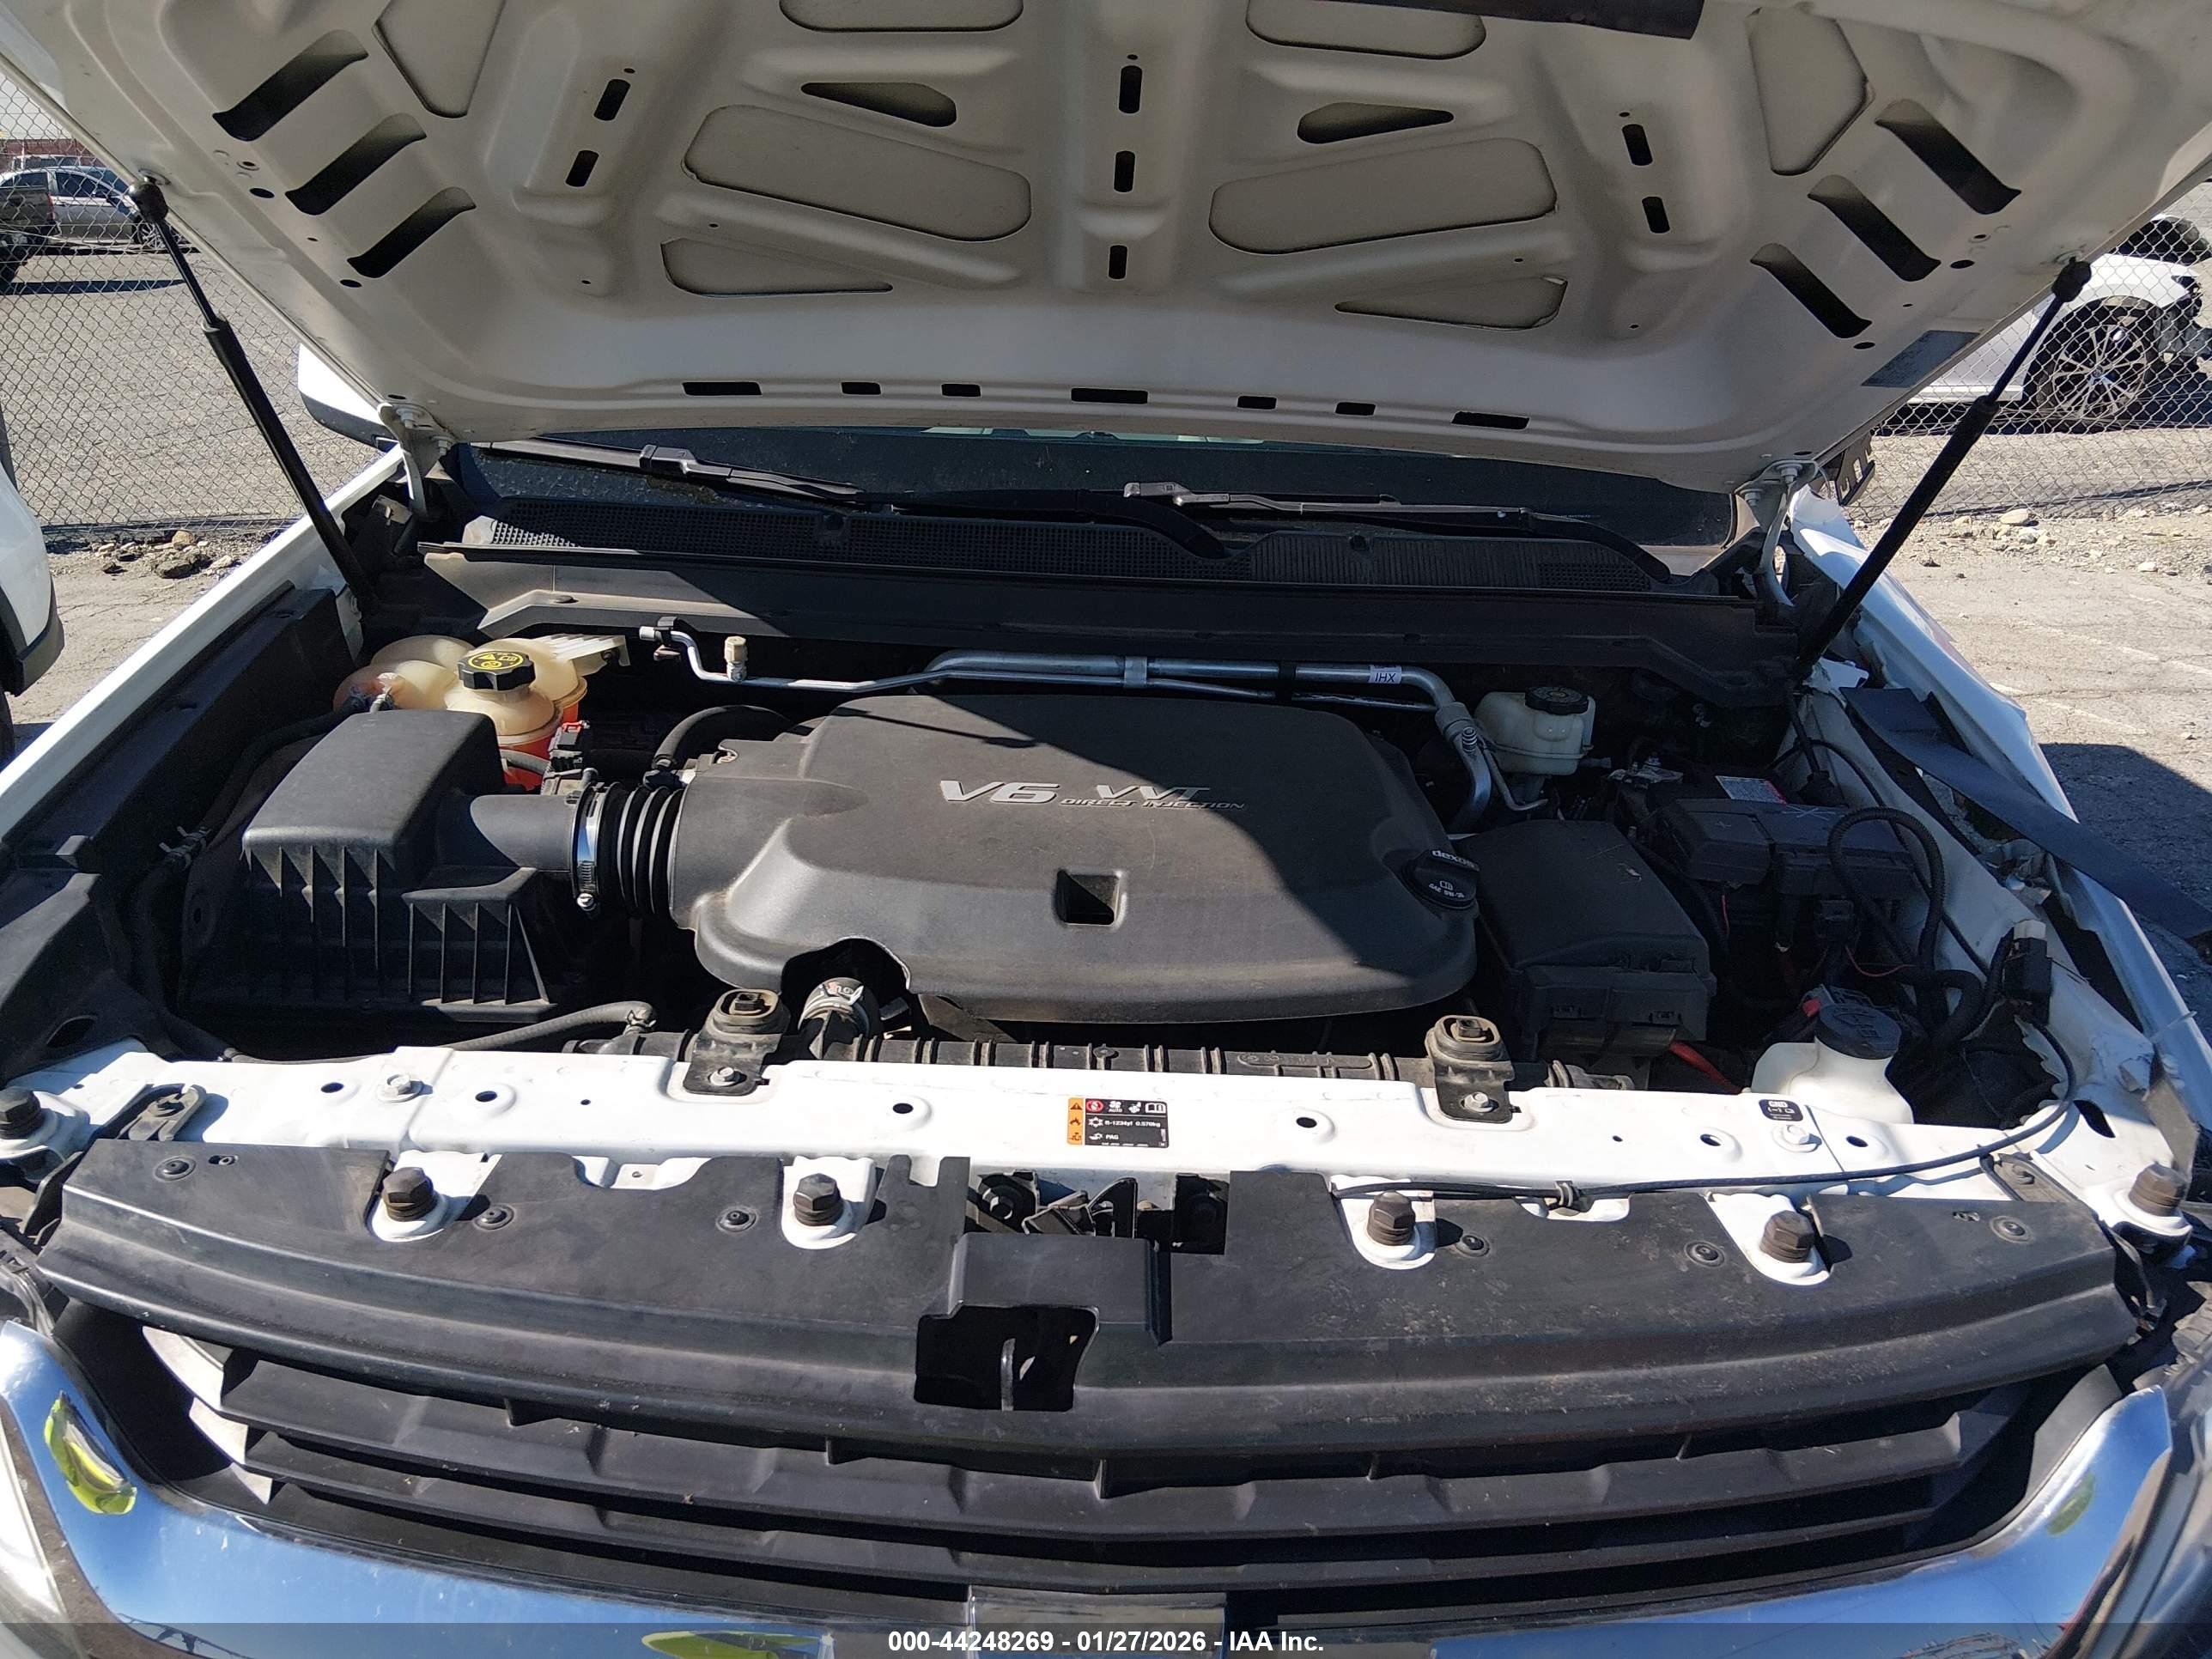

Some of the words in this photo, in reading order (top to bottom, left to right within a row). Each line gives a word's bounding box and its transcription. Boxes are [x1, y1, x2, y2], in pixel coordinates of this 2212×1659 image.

[1375, 672, 1396, 683] IHX
[940, 780, 1060, 804] V6
[1096, 784, 1212, 801] VVT
[1060, 798, 1138, 807] DIRECT
[1141, 799, 1245, 810] INJECTION
